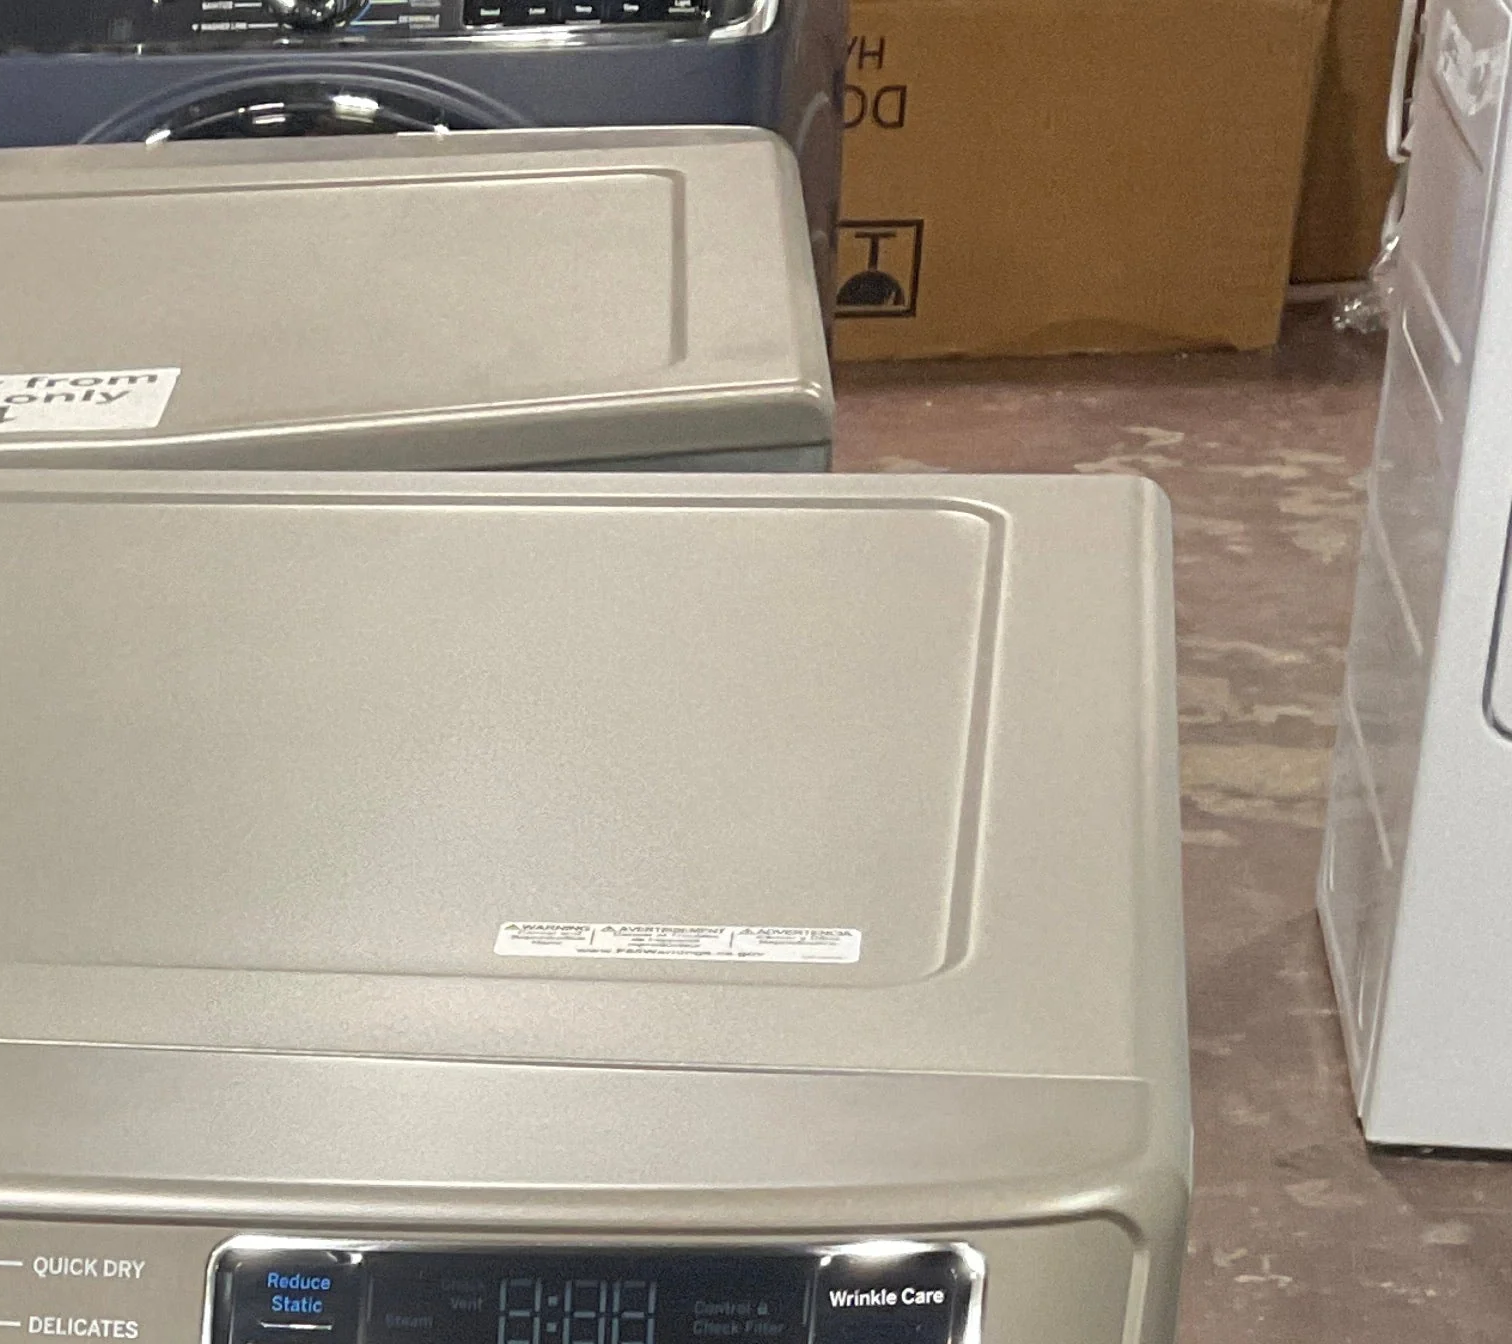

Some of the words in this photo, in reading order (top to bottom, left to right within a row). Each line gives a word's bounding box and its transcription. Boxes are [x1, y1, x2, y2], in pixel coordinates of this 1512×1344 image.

[24, 373, 158, 389] from
[4, 389, 133, 405] only
[33, 1256, 98, 1278] QUICK
[103, 1259, 146, 1279] DRY
[267, 1272, 331, 1290] Reduce
[271, 1295, 324, 1313] Static
[829, 1288, 897, 1307] Wrinkle
[901, 1287, 945, 1305] Care
[28, 1315, 139, 1339] DELICATES
